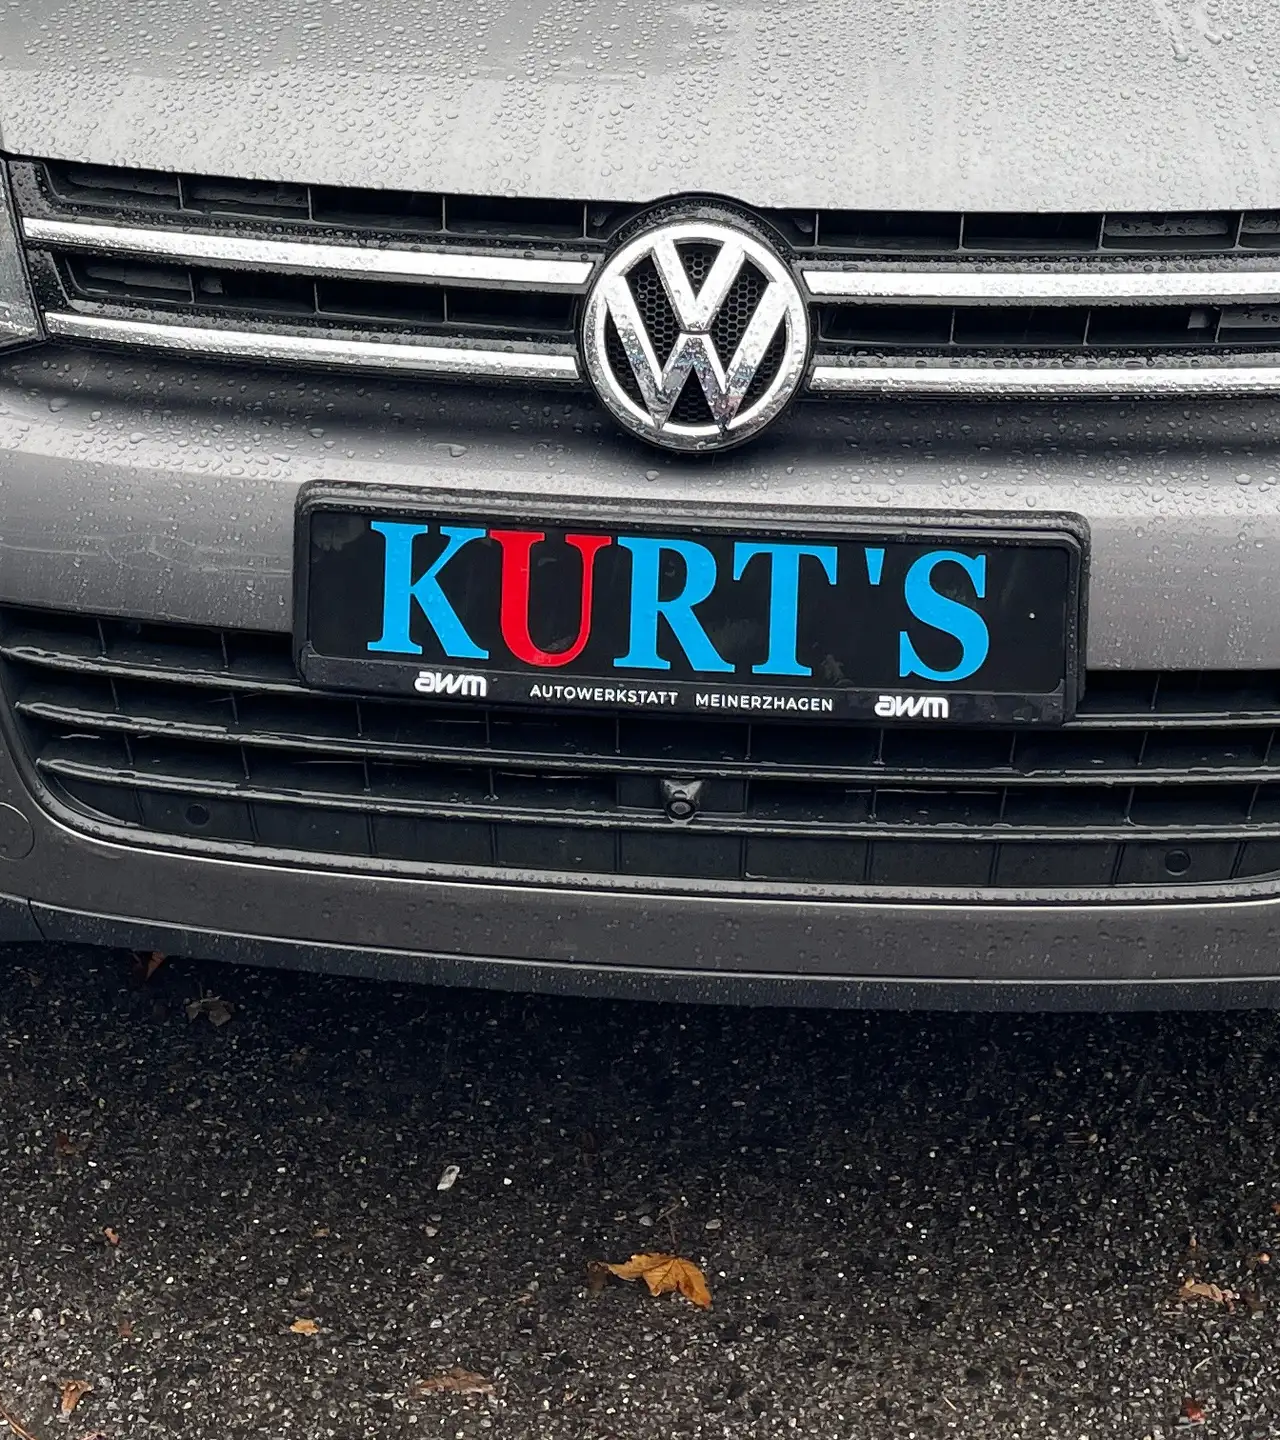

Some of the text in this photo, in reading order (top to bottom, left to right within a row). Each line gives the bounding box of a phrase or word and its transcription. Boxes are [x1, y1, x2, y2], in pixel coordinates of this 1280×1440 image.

[367, 520, 990, 682] KURT'S
[414, 671, 949, 719] awm AUTOWERKSTATT MEINERZHAGEN awm
